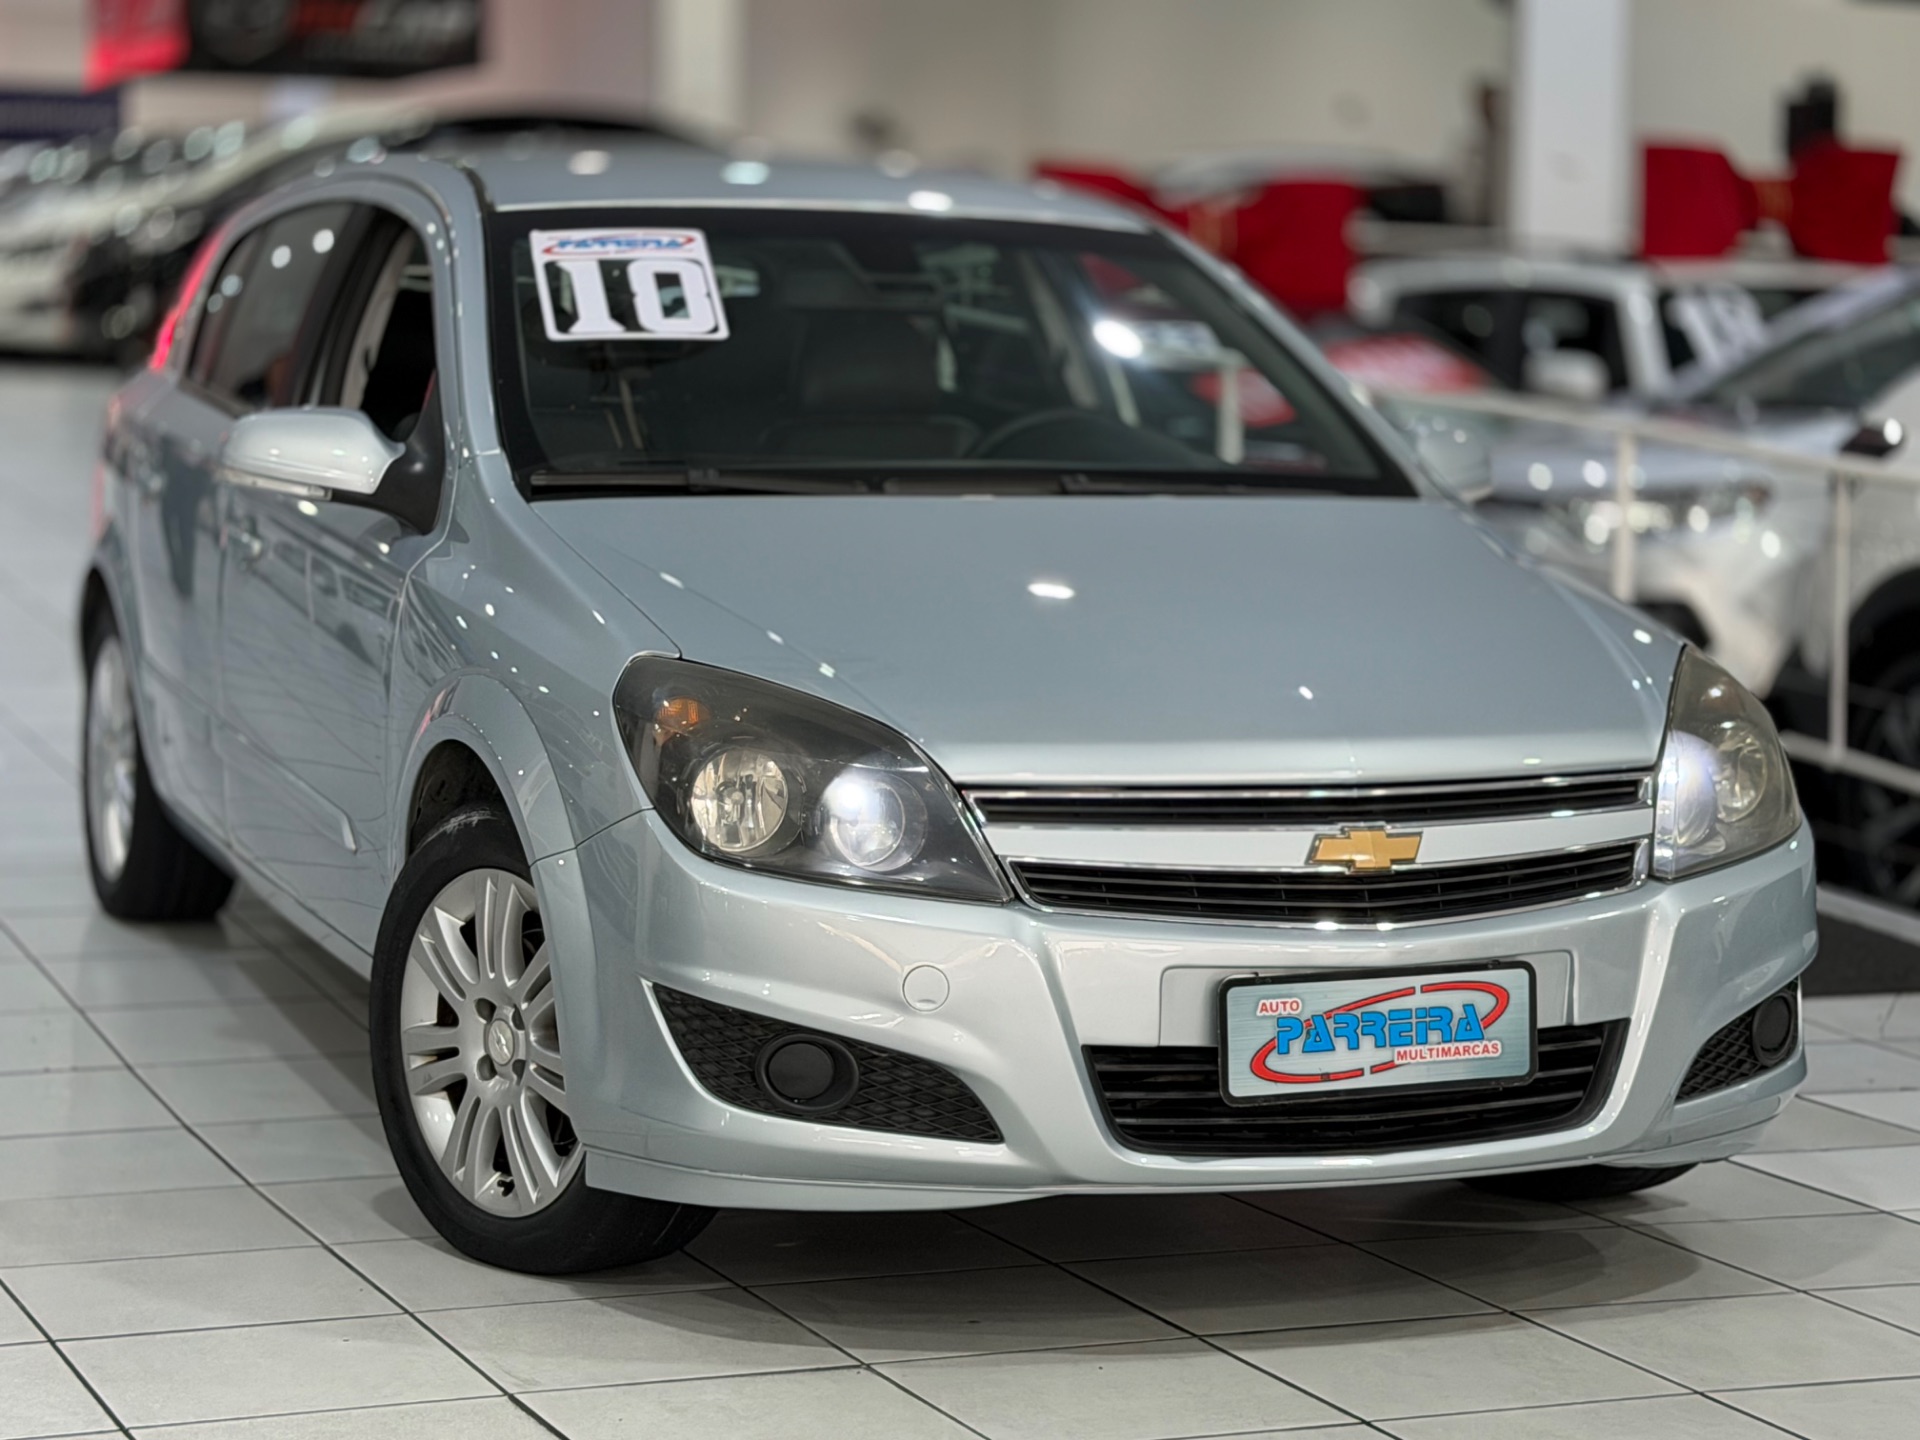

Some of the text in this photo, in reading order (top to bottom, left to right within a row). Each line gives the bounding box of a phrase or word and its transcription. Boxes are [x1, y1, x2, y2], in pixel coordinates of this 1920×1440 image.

[1258, 1000, 1301, 1014] AUTO
[1277, 1004, 1485, 1055] PARREIRA
[1397, 1043, 1500, 1061] MULTIMARCAS
